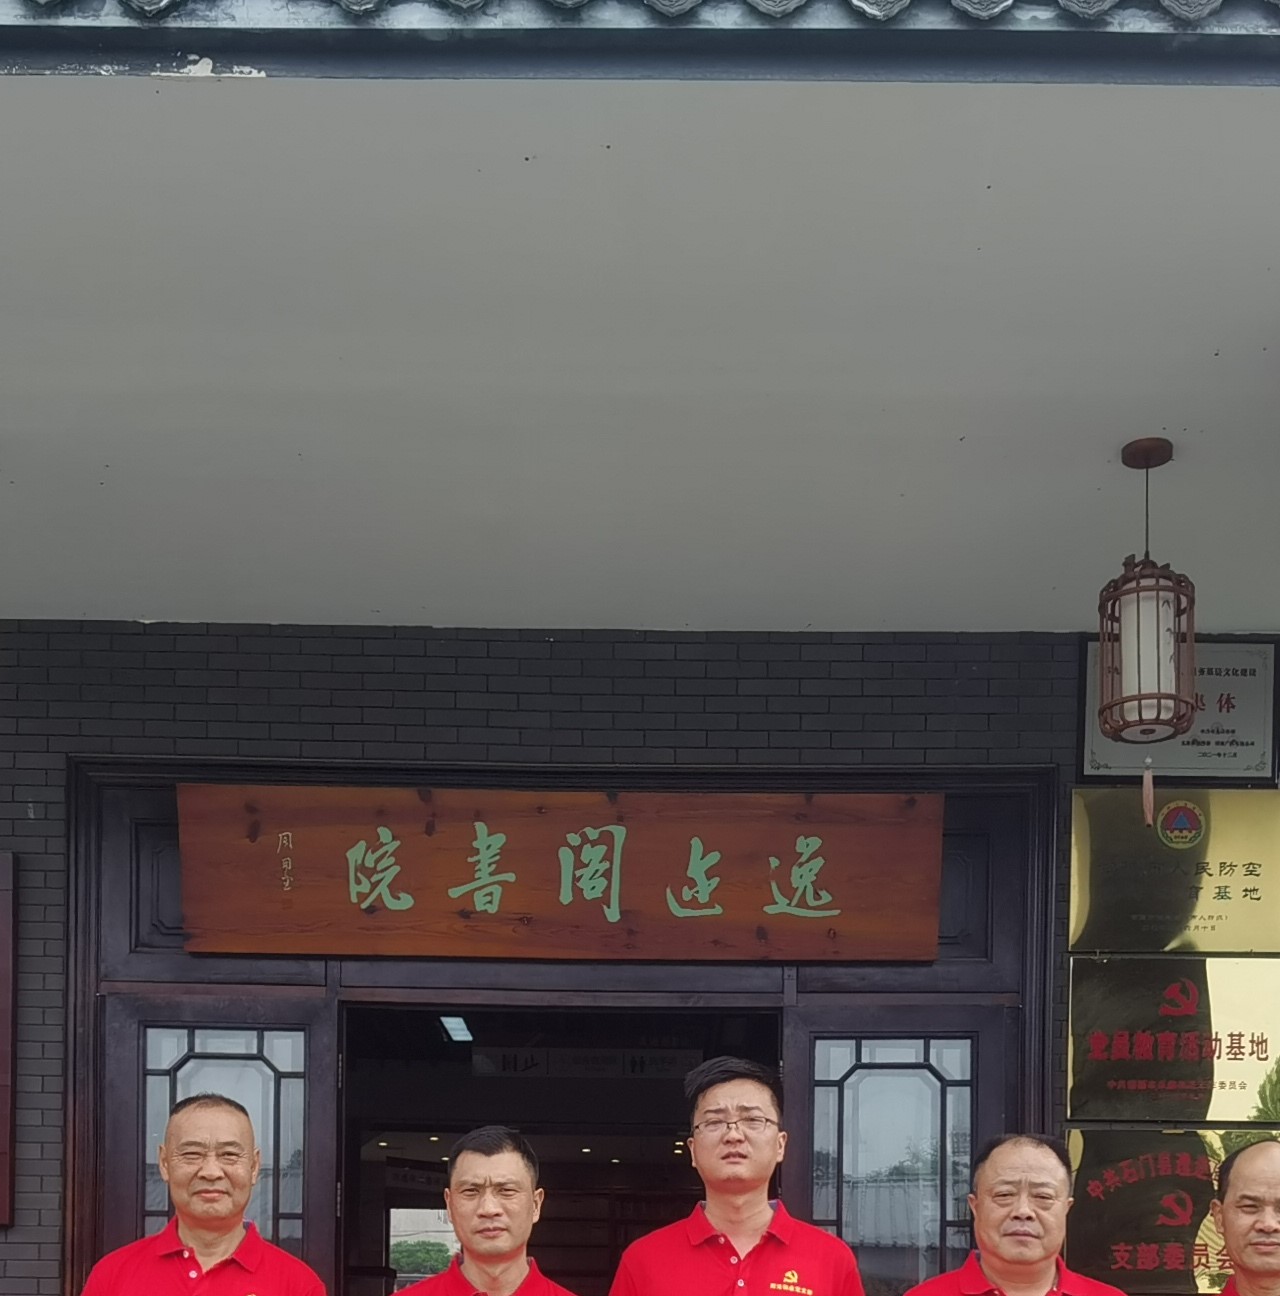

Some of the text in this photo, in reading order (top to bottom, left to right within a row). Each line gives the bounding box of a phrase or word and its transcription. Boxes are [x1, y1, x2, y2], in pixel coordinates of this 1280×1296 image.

[1194, 666, 1257, 677] 务基层文化建设
